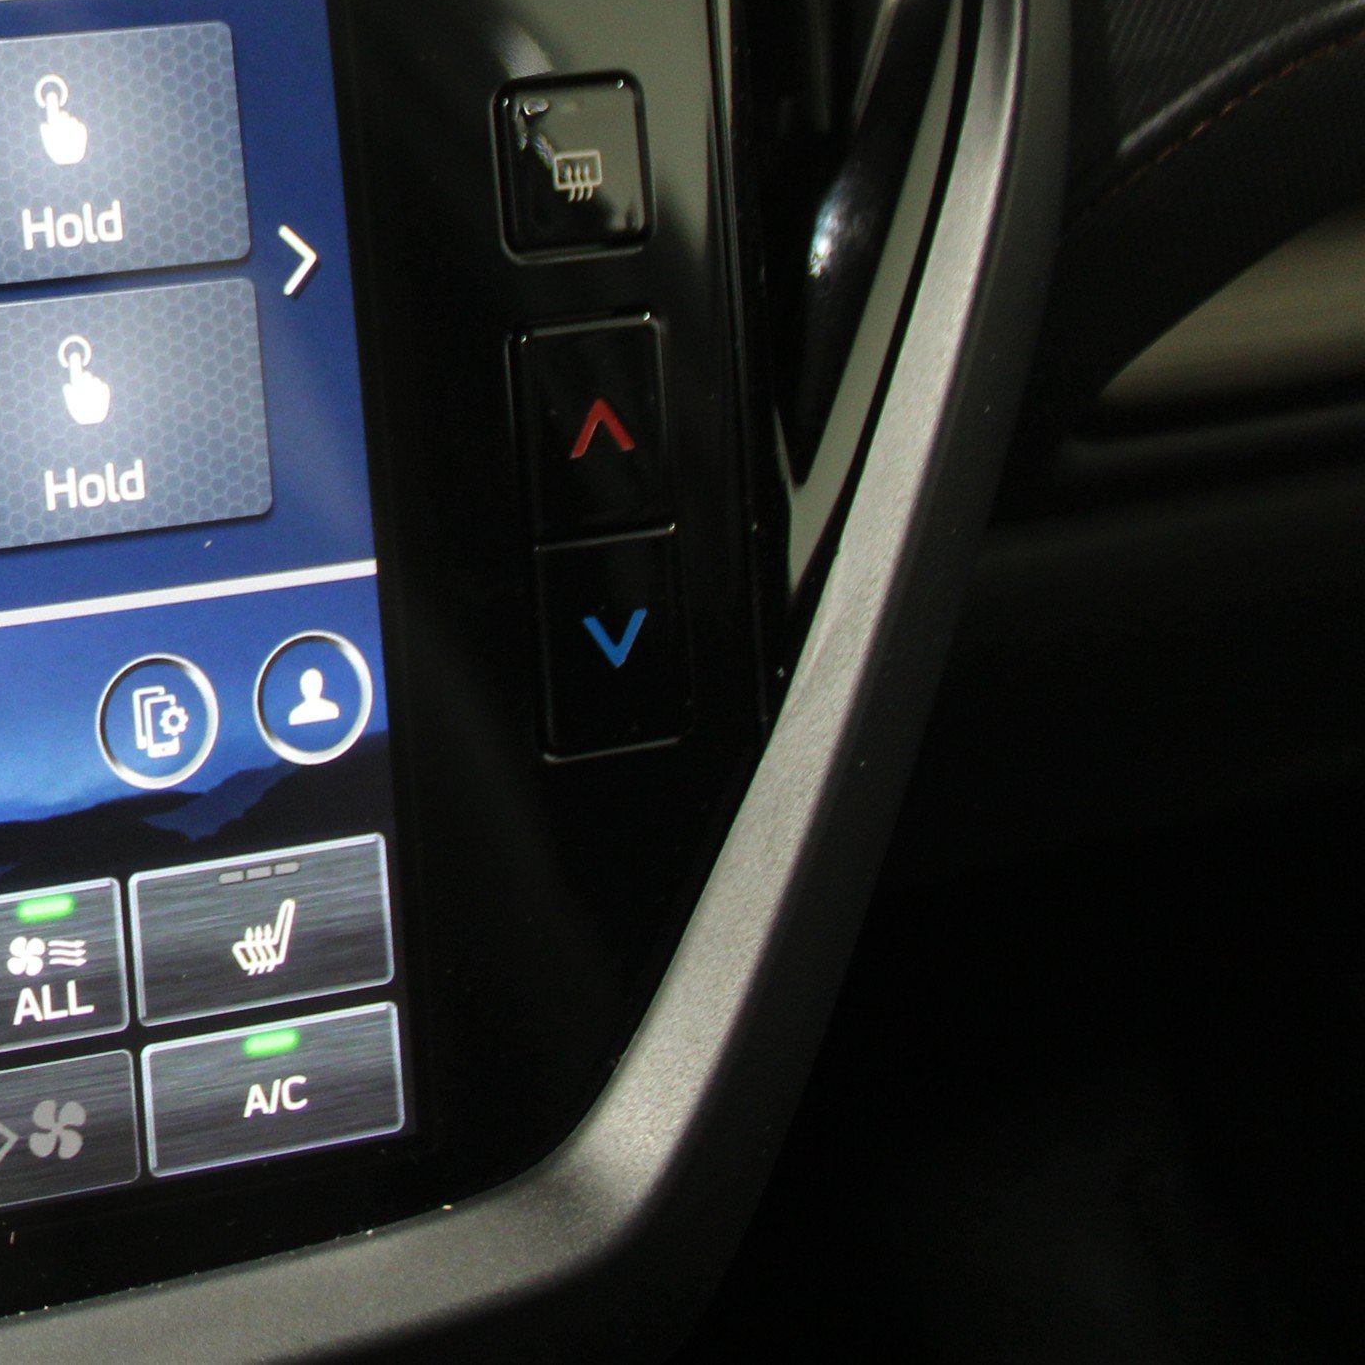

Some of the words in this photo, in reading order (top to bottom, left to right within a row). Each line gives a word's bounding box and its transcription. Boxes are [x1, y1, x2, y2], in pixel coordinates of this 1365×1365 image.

[21, 199, 125, 251] Hold
[43, 458, 148, 512] Hold
[12, 980, 95, 1027] ALL
[242, 1074, 310, 1120] A/C
